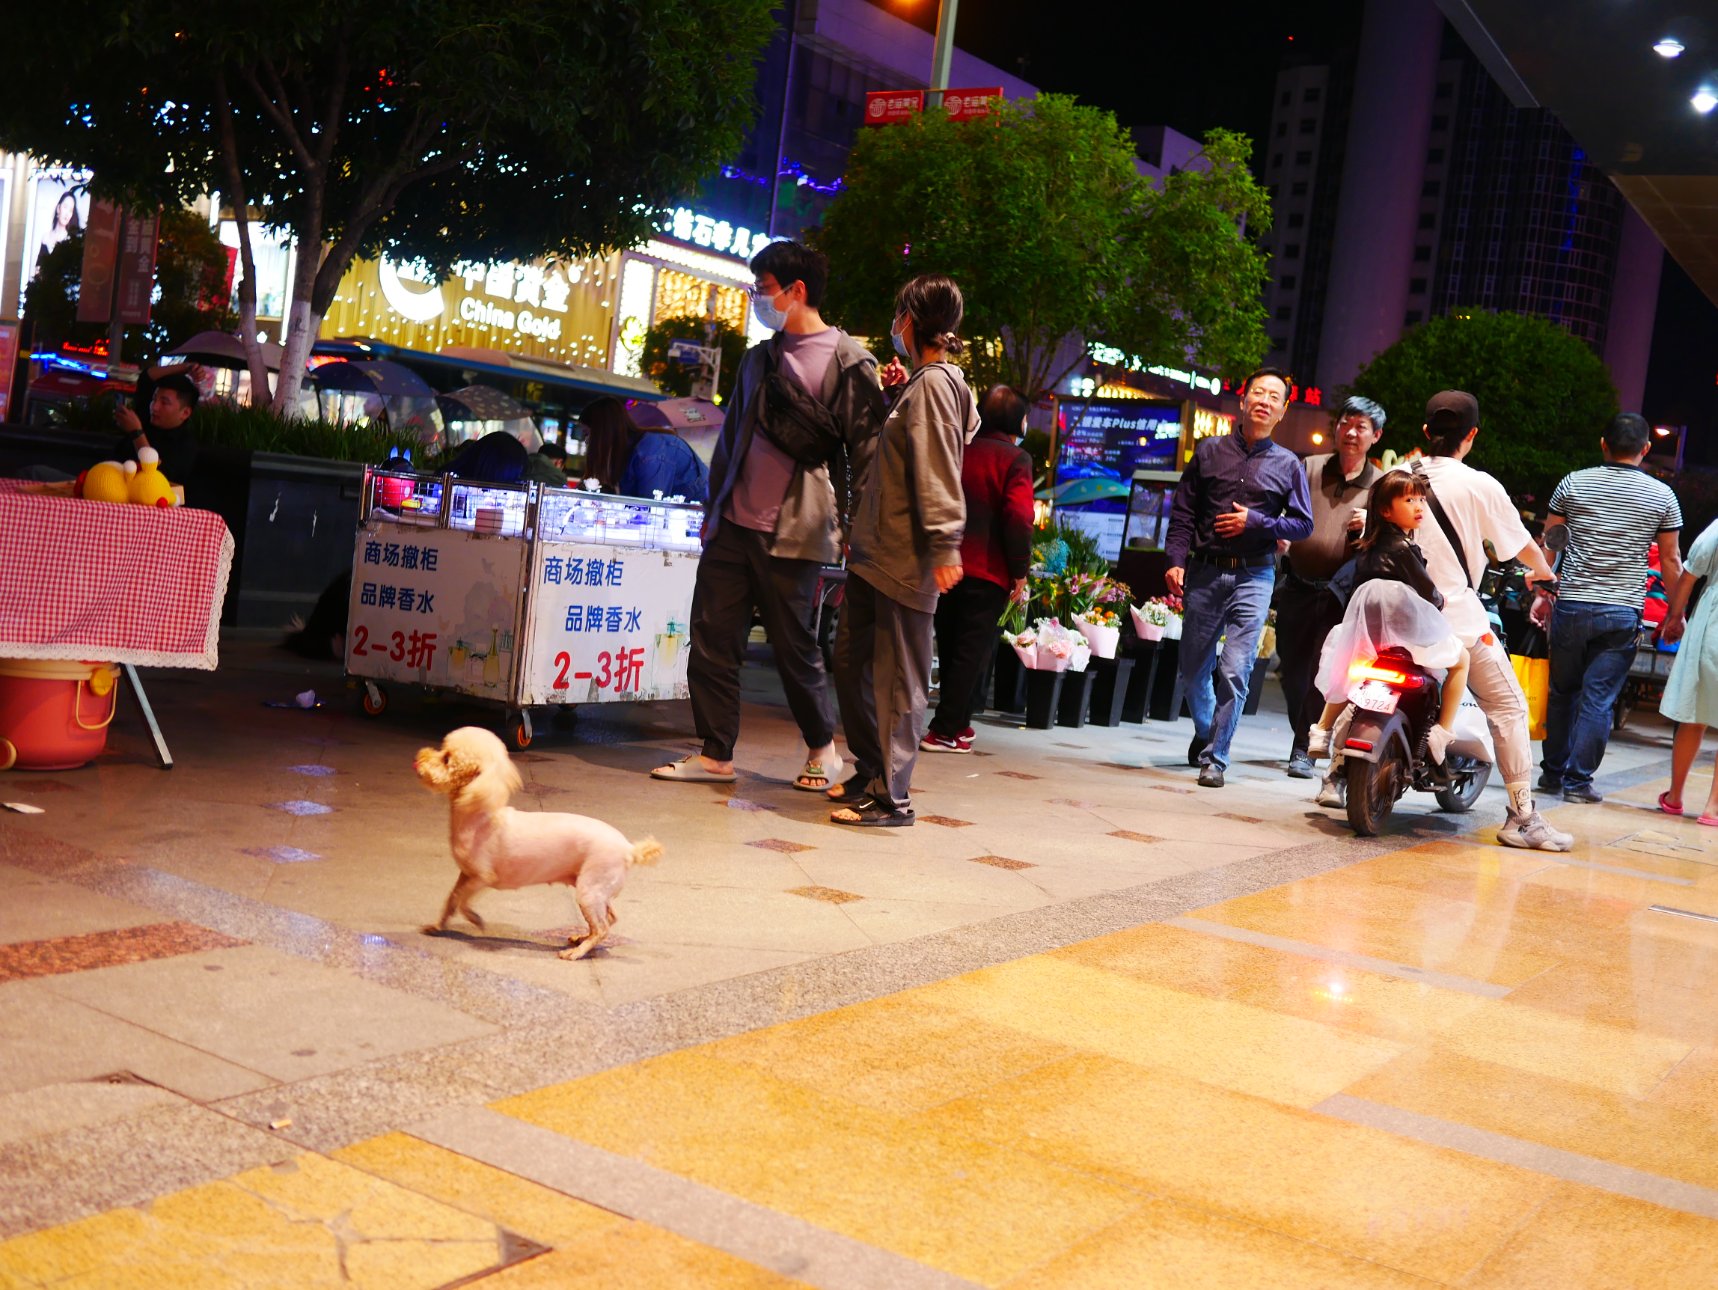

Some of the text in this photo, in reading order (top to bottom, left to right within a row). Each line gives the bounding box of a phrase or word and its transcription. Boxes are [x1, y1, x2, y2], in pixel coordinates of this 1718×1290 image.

[460, 297, 561, 340] China Gold
[363, 541, 438, 571] 商场撤柜
[543, 556, 624, 587] 商场撤柜
[360, 582, 434, 614] 品牌香水
[565, 605, 643, 633] 品牌香水
